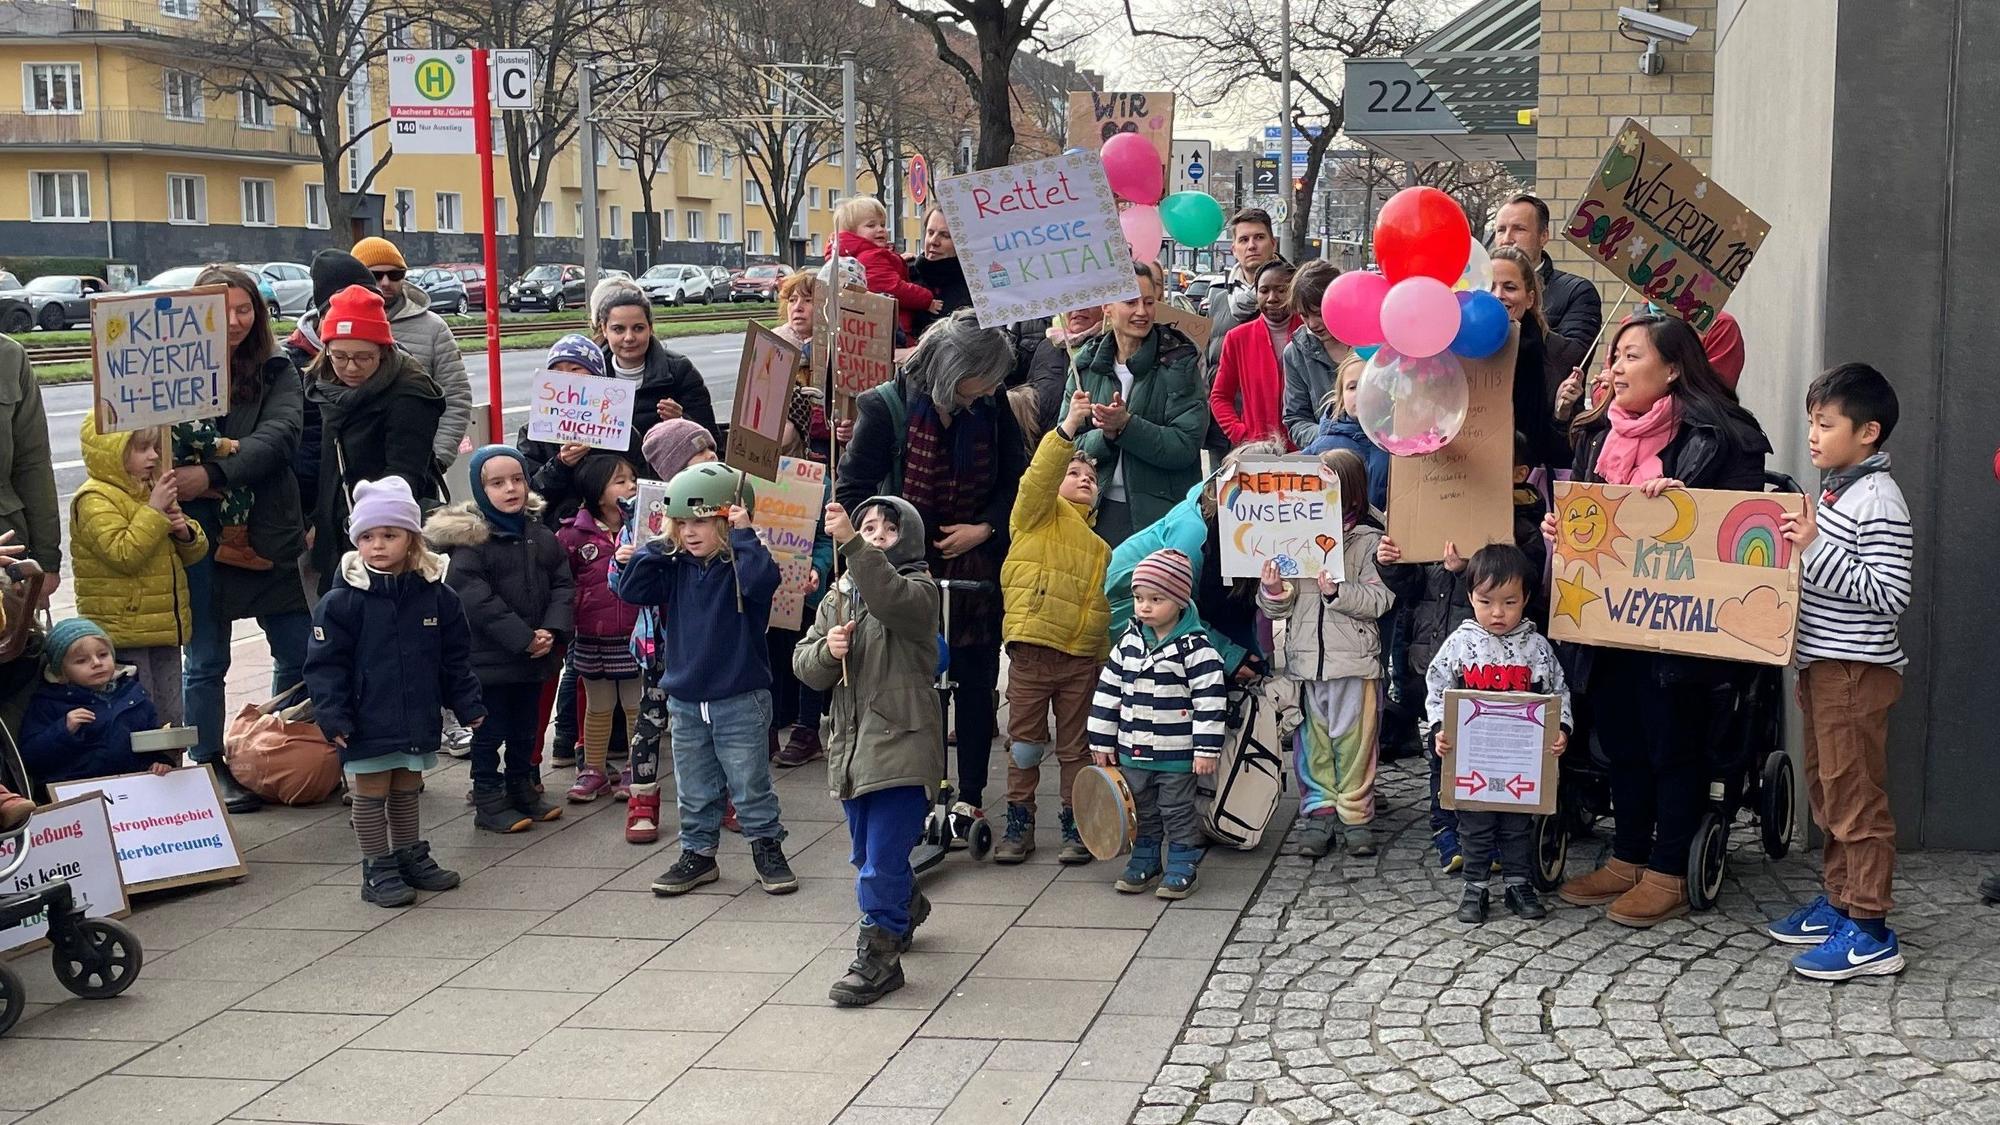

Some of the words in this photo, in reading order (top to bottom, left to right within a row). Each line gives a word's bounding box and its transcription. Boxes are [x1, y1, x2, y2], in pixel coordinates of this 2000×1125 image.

[498, 56, 528, 66] Bussteig
[425, 66, 445, 92] H
[503, 68, 527, 99] C
[1368, 80, 1436, 112] 222
[396, 108, 431, 116] Aachener
[398, 123, 415, 132] 140
[433, 124, 462, 132] Ausstieg
[972, 171, 1079, 219] Rettet
[1623, 142, 1725, 265] WEYERTAL
[992, 220, 1091, 252] unsere
[1018, 240, 1116, 283] KITA!
[1628, 243, 1715, 332] bleiben
[842, 318, 878, 340] ICHT
[106, 340, 220, 379] WEYERTAL
[838, 355, 887, 380] EINEM
[539, 406, 593, 422] unsere
[601, 413, 625, 428] Kita
[559, 420, 622, 439] NICHT!!!
[1235, 502, 1324, 523] UNSERE
[1251, 535, 1312, 557] KITA
[1604, 586, 1719, 633] WEYERTAL
[112, 807, 214, 834] strophengebiet
[117, 833, 224, 862] derbetreuung
[14, 872, 35, 892] ist
[39, 860, 82, 884] keine
